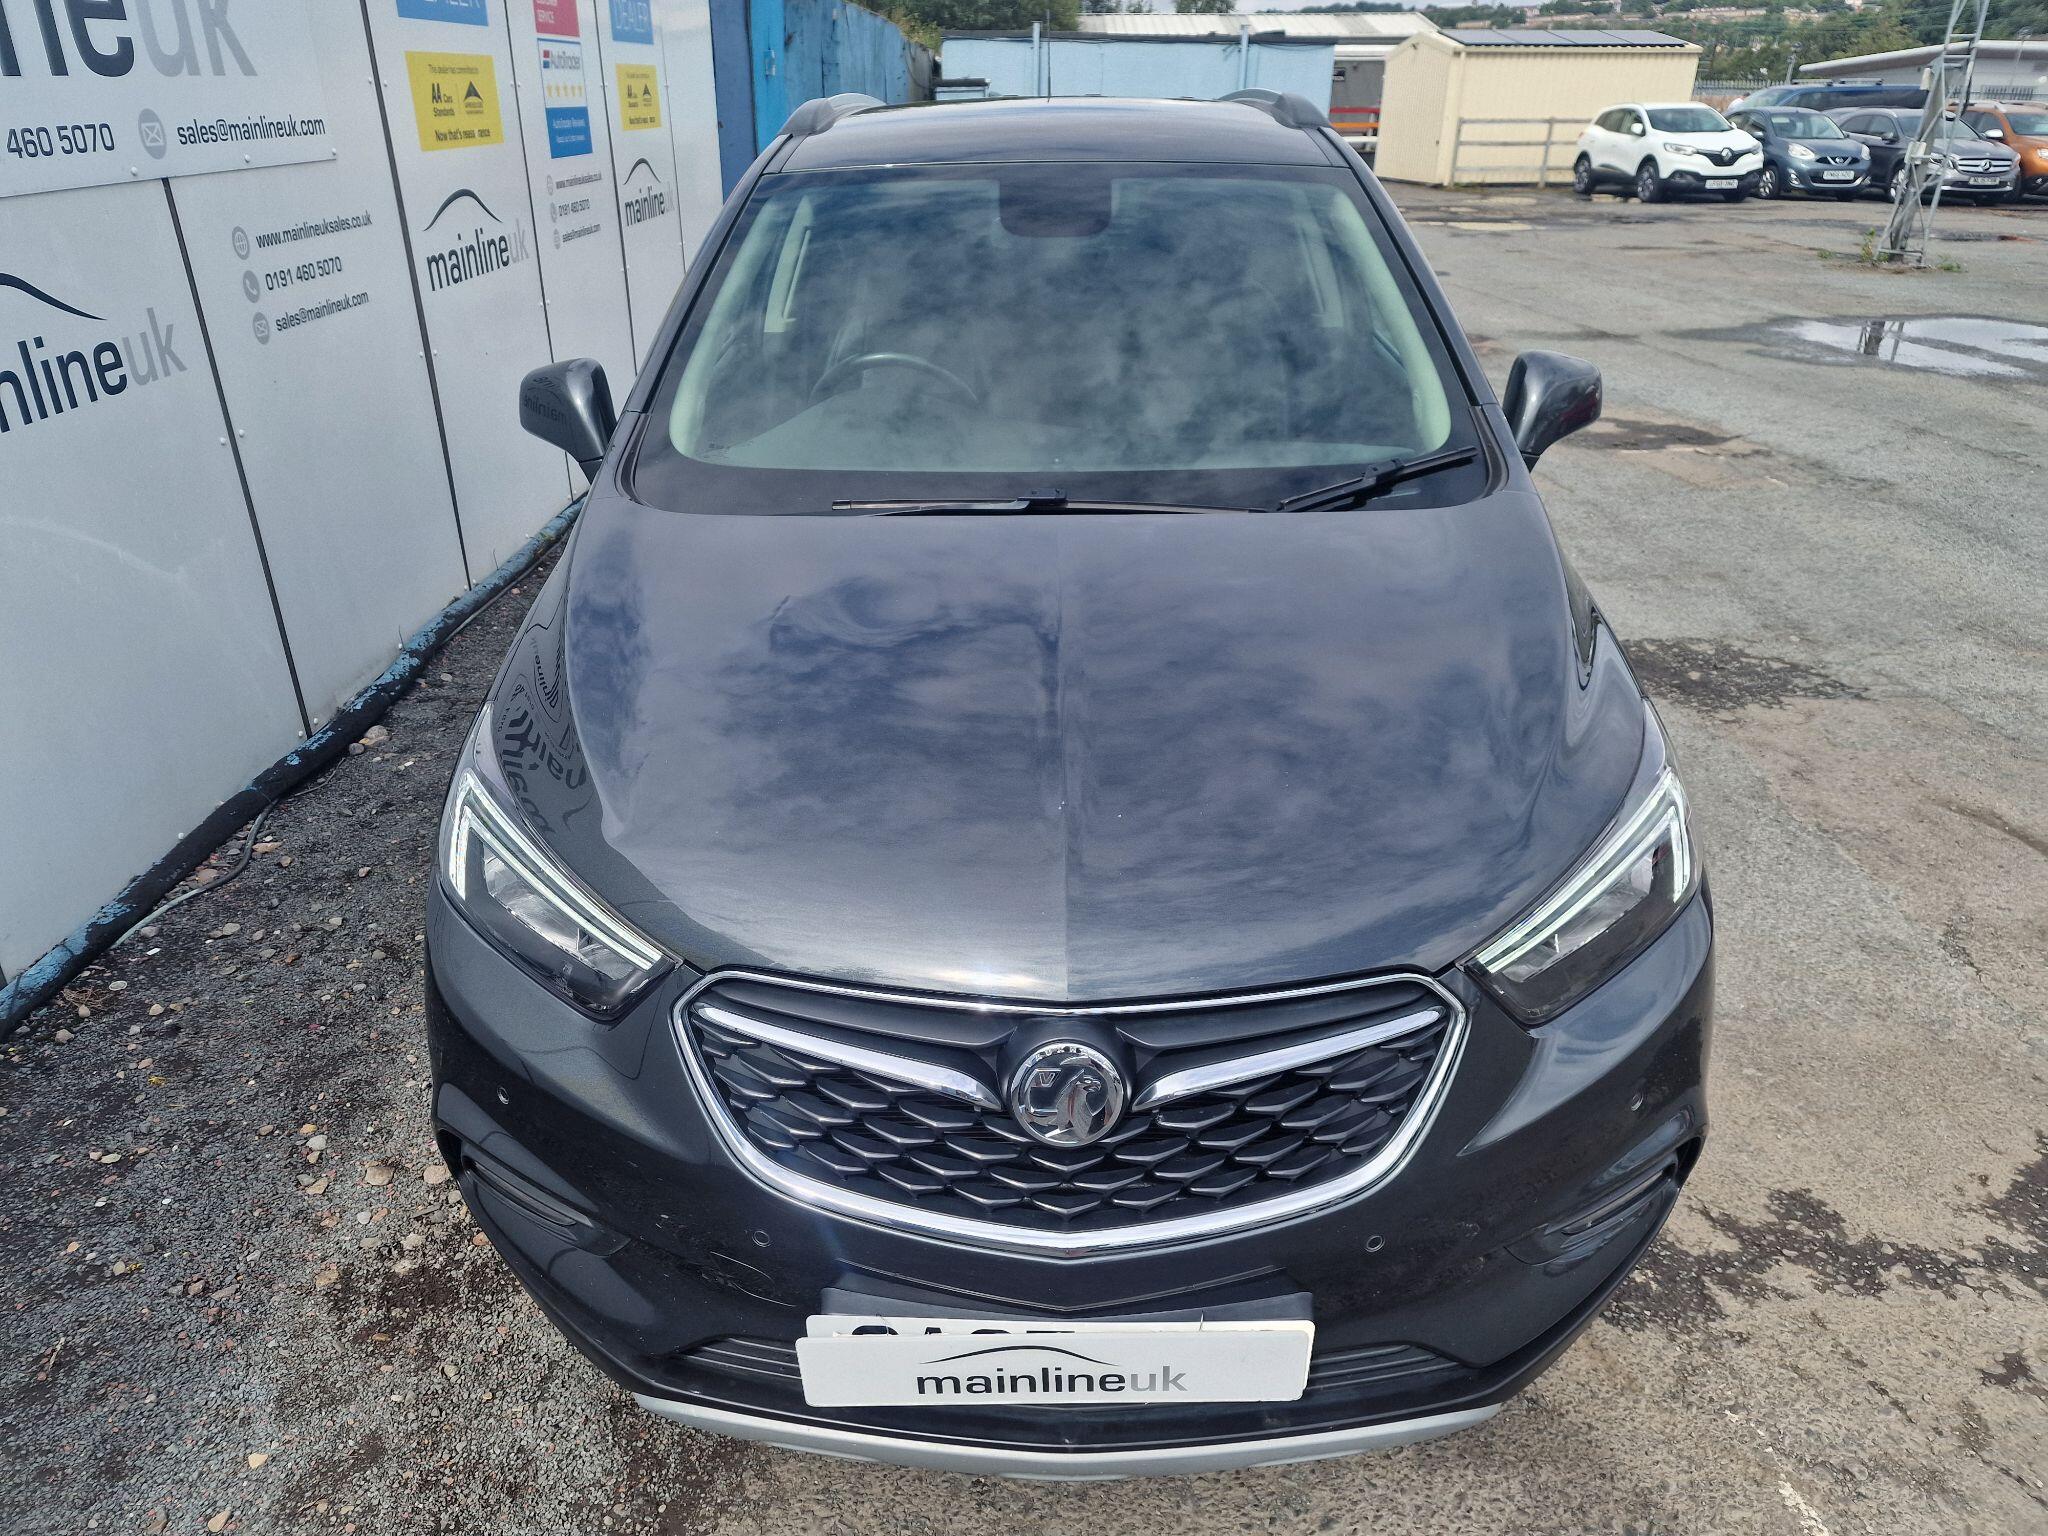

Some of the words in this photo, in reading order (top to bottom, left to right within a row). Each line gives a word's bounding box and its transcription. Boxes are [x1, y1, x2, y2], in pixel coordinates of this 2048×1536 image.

[7, 127, 54, 159] 460
[56, 122, 115, 155] 5070
[176, 115, 326, 146] sales@mainlineuk.com
[256, 210, 373, 249] www.mainlineuksales.co.uk
[265, 268, 293, 292] 0191
[295, 262, 316, 284] 460
[317, 256, 342, 279] 5070
[426, 219, 530, 292] mainlineuk
[275, 290, 369, 332] sales@mainlineuk.com
[916, 1366, 1188, 1395] mainlineuk
